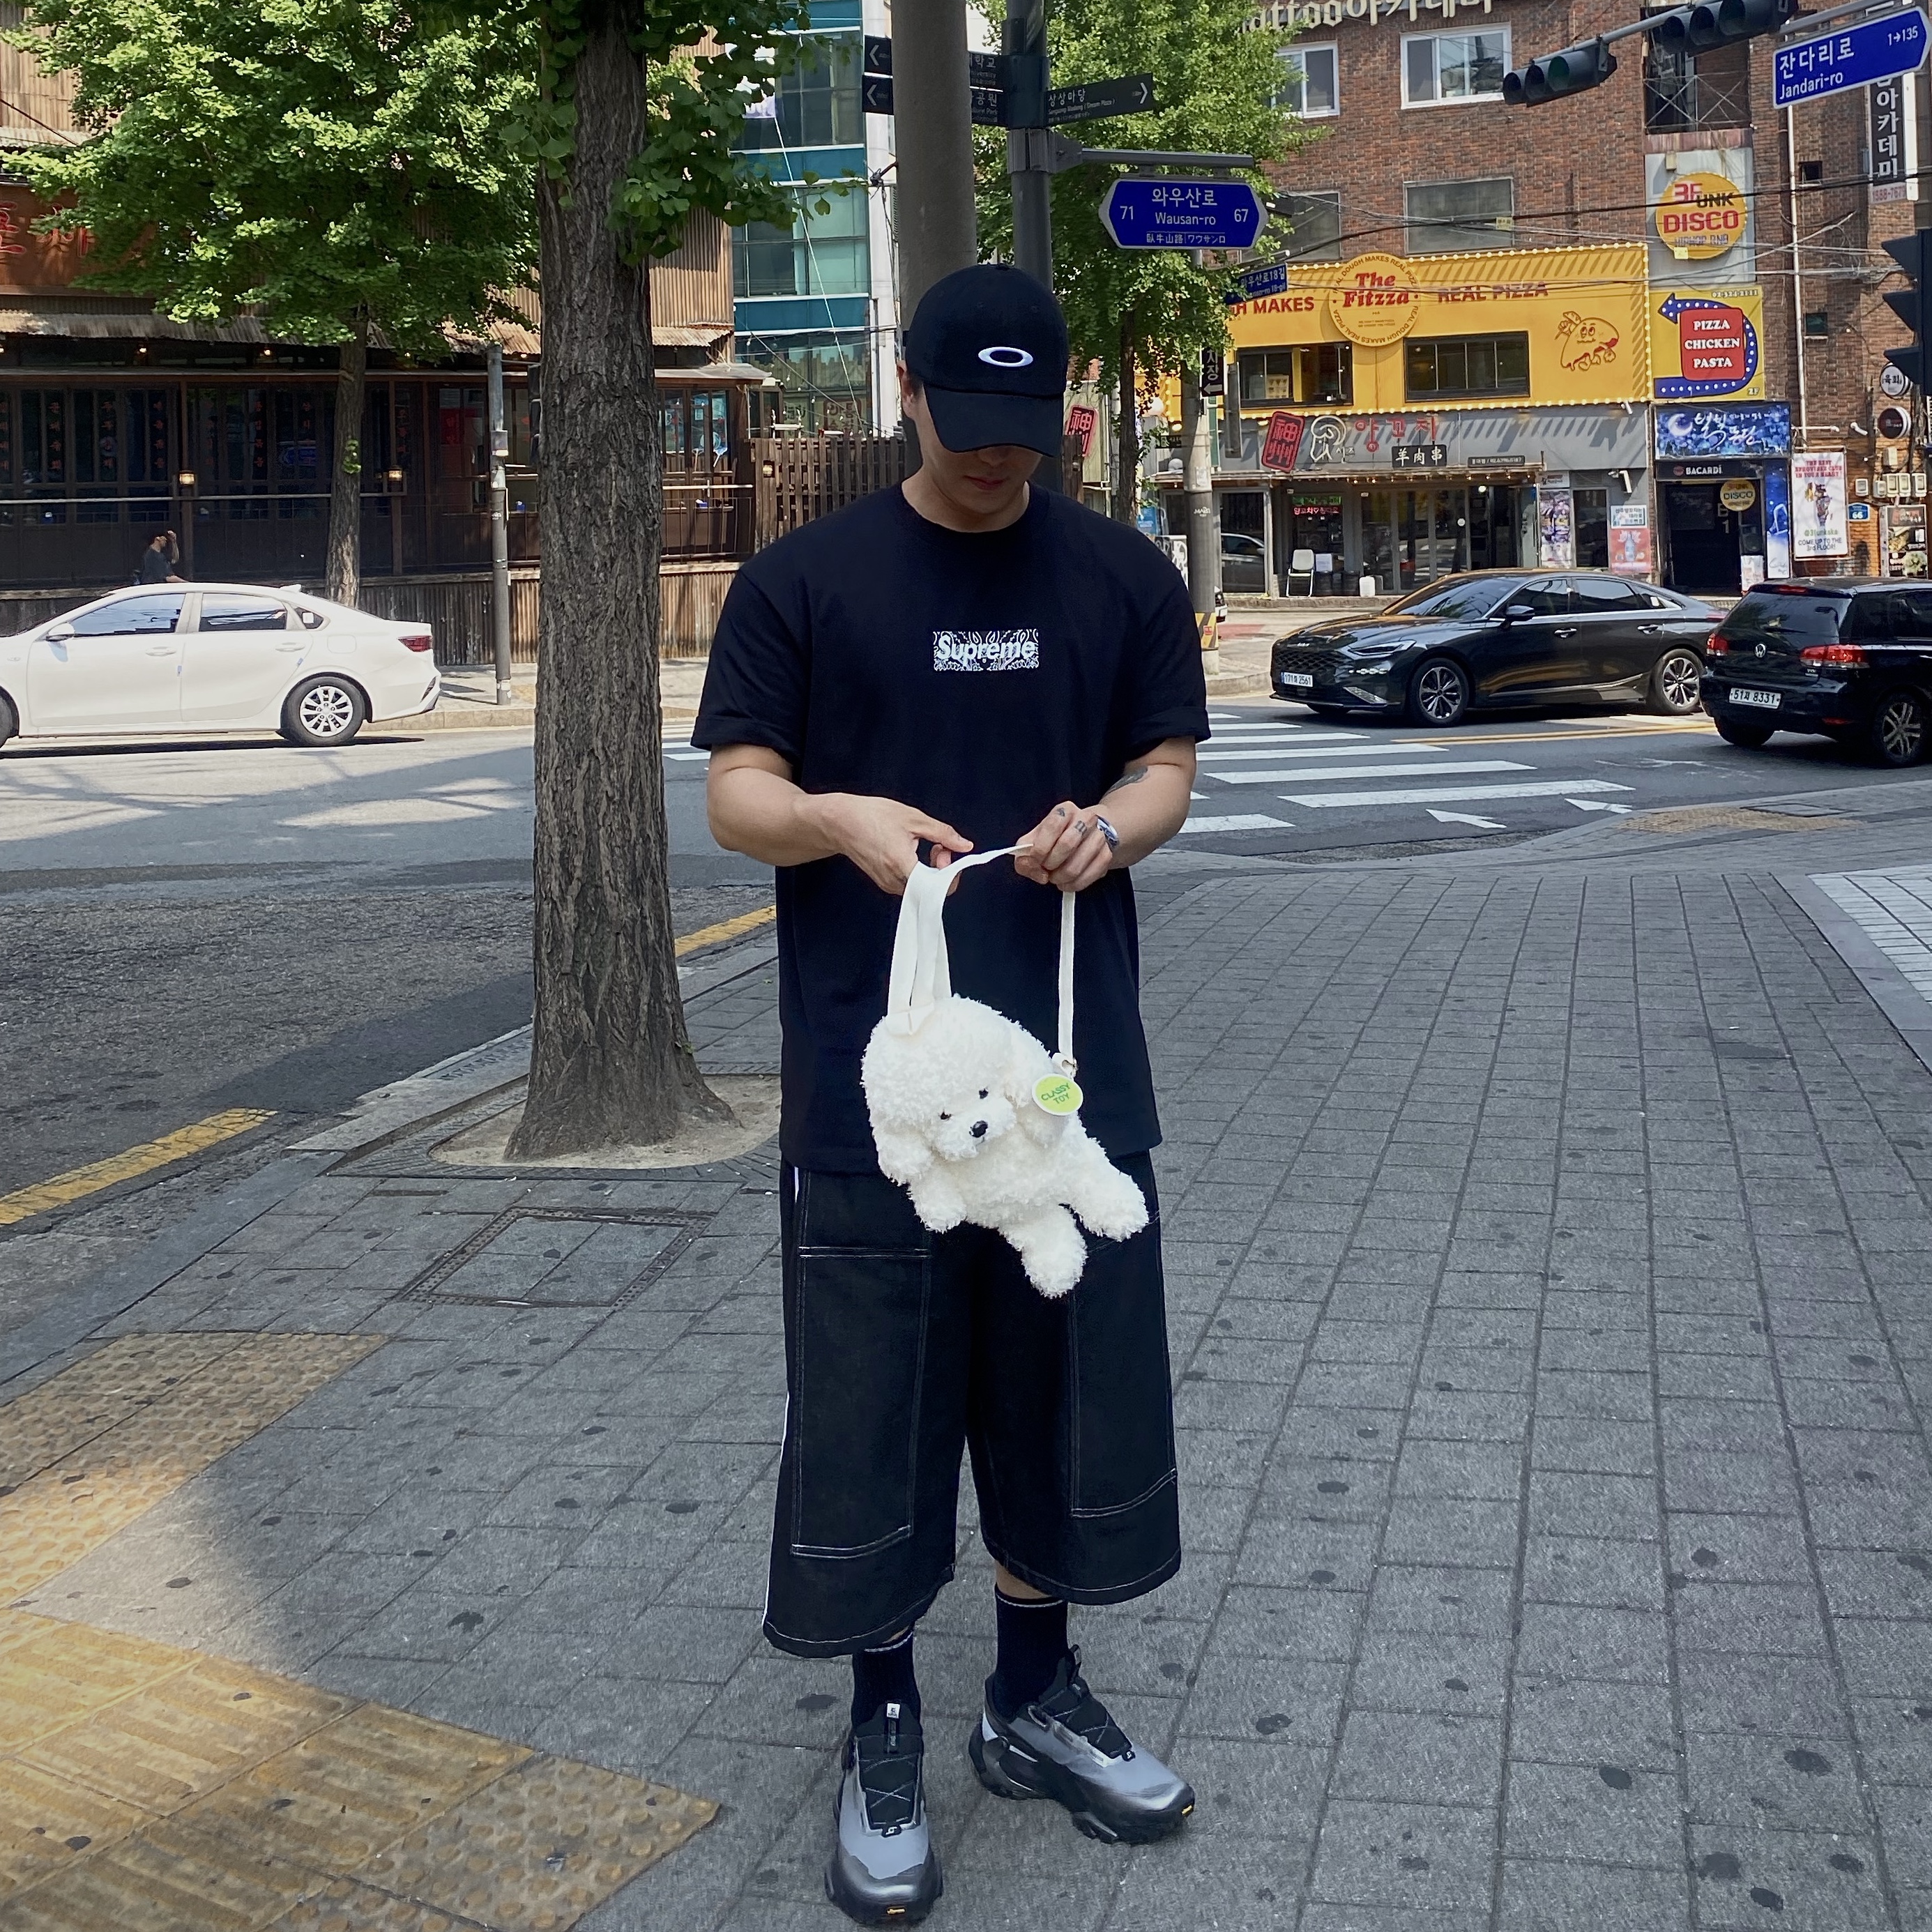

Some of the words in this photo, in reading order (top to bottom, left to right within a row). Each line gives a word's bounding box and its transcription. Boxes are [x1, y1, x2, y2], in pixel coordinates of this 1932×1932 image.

[1779, 37, 1855, 79] 잔다리로
[1779, 72, 1843, 100] Jandari-ro
[1048, 88, 1086, 107] 상상마당
[1152, 187, 1217, 208] 와우산로
[1120, 206, 1134, 220] 71
[1155, 212, 1216, 225] Wausan-ro
[1234, 208, 1249, 222] 67
[1664, 211, 1739, 234] DISCO
[1341, 259, 1364, 276] DOUGH
[1390, 259, 1407, 273] REAL
[1355, 271, 1396, 288] The
[1342, 290, 1410, 307] Fitzza
[1438, 286, 1486, 303] REAL
[1493, 281, 1549, 299] PIZZA
[1253, 296, 1314, 314] MAKES
[1407, 305, 1419, 322] REAL
[1693, 319, 1731, 330] PIZZA
[1344, 328, 1360, 341] REAL
[1684, 338, 1740, 350] CHICKEN
[1693, 357, 1733, 369] PASTA
[1041, 386, 1070, 404] CLASSY
[1053, 395, 1070, 407] TOY
[1395, 446, 1443, 466] 羊肉串
[1724, 491, 1754, 500] DISCO
[936, 634, 1037, 667] Supreme
[1298, 676, 1311, 685] 2561
[1753, 692, 1776, 704] 8331
